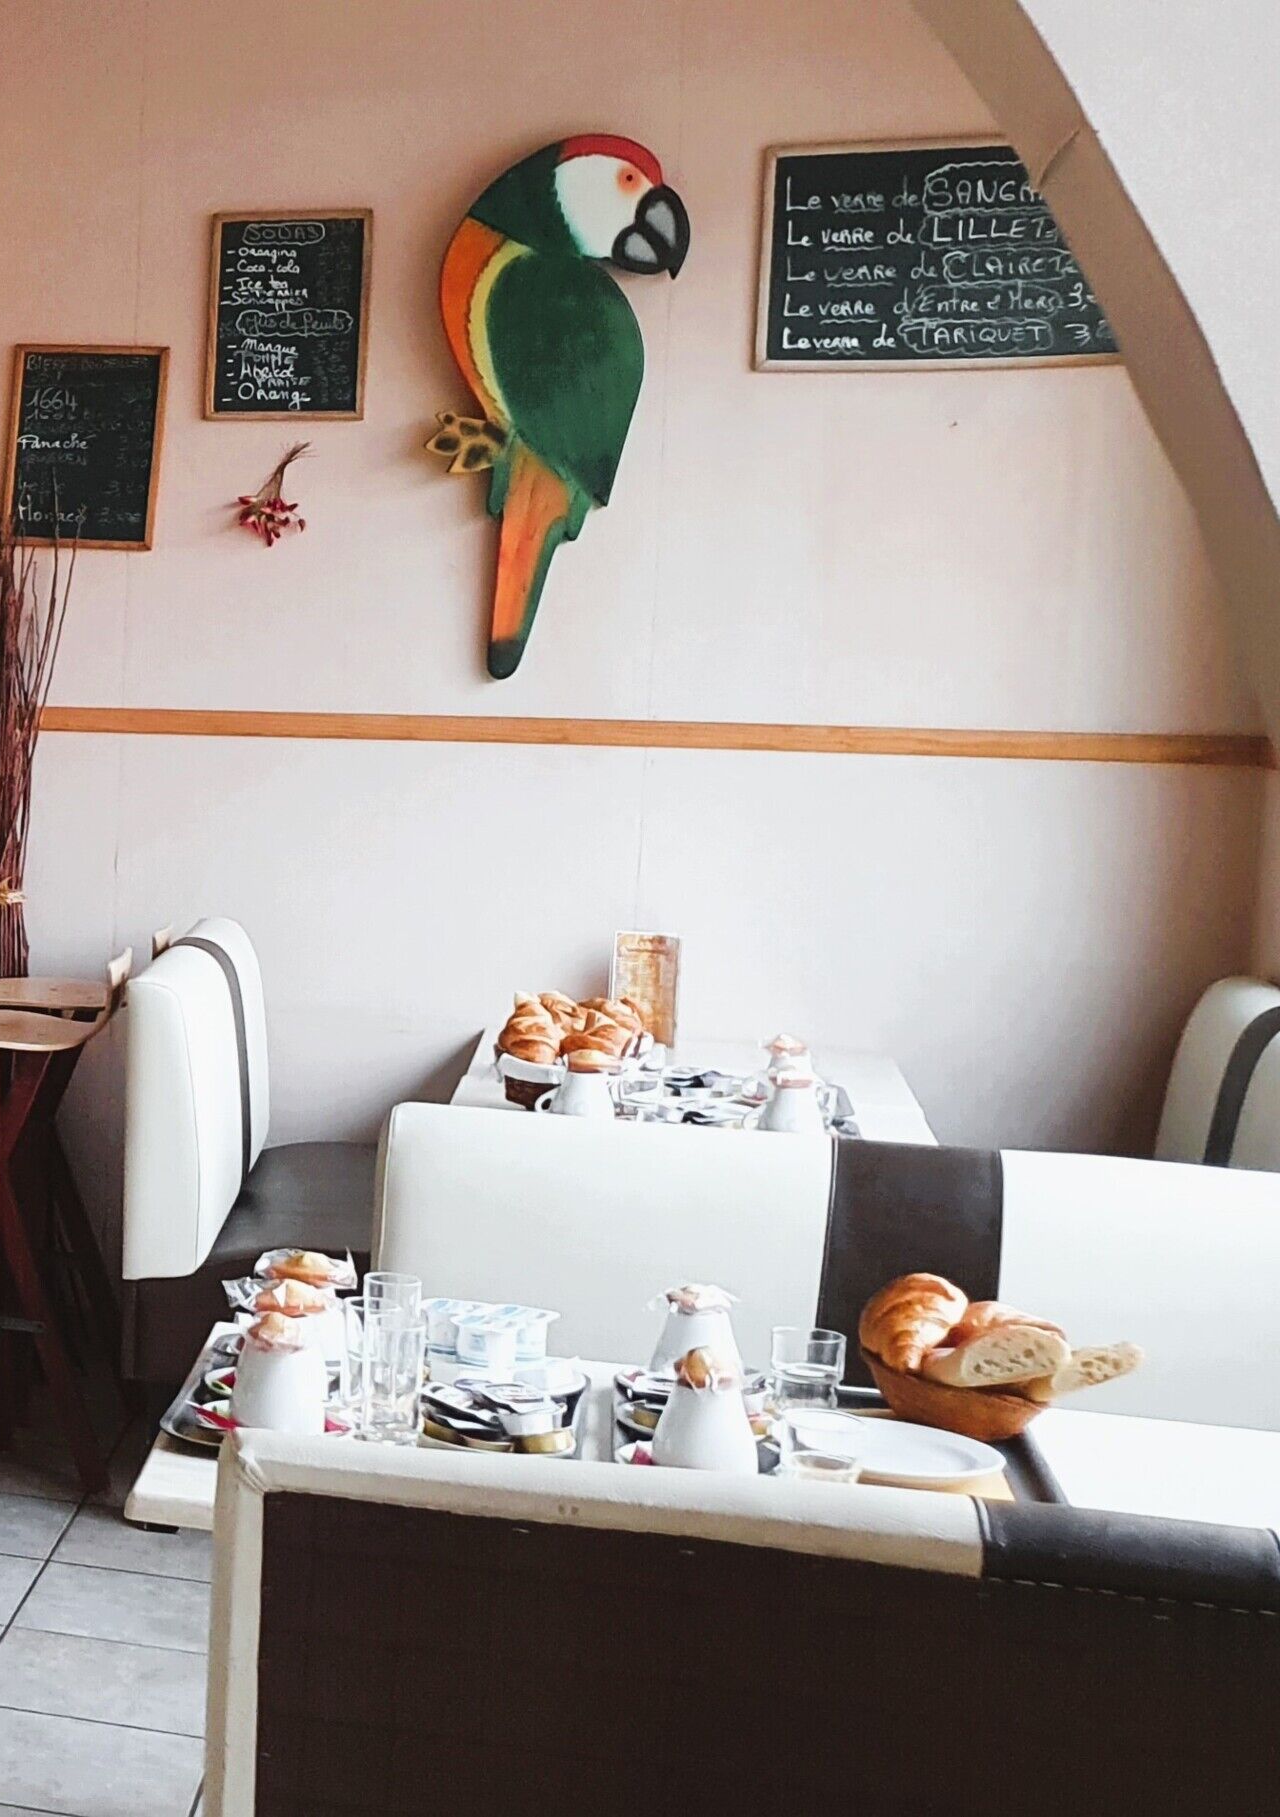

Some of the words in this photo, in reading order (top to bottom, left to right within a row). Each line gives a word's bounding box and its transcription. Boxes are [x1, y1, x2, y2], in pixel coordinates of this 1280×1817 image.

[786, 176, 822, 211] Le
[787, 220, 814, 247] Le
[886, 218, 916, 245] de
[787, 256, 816, 281] Le
[783, 292, 813, 317] Le
[25, 386, 79, 412] 1664
